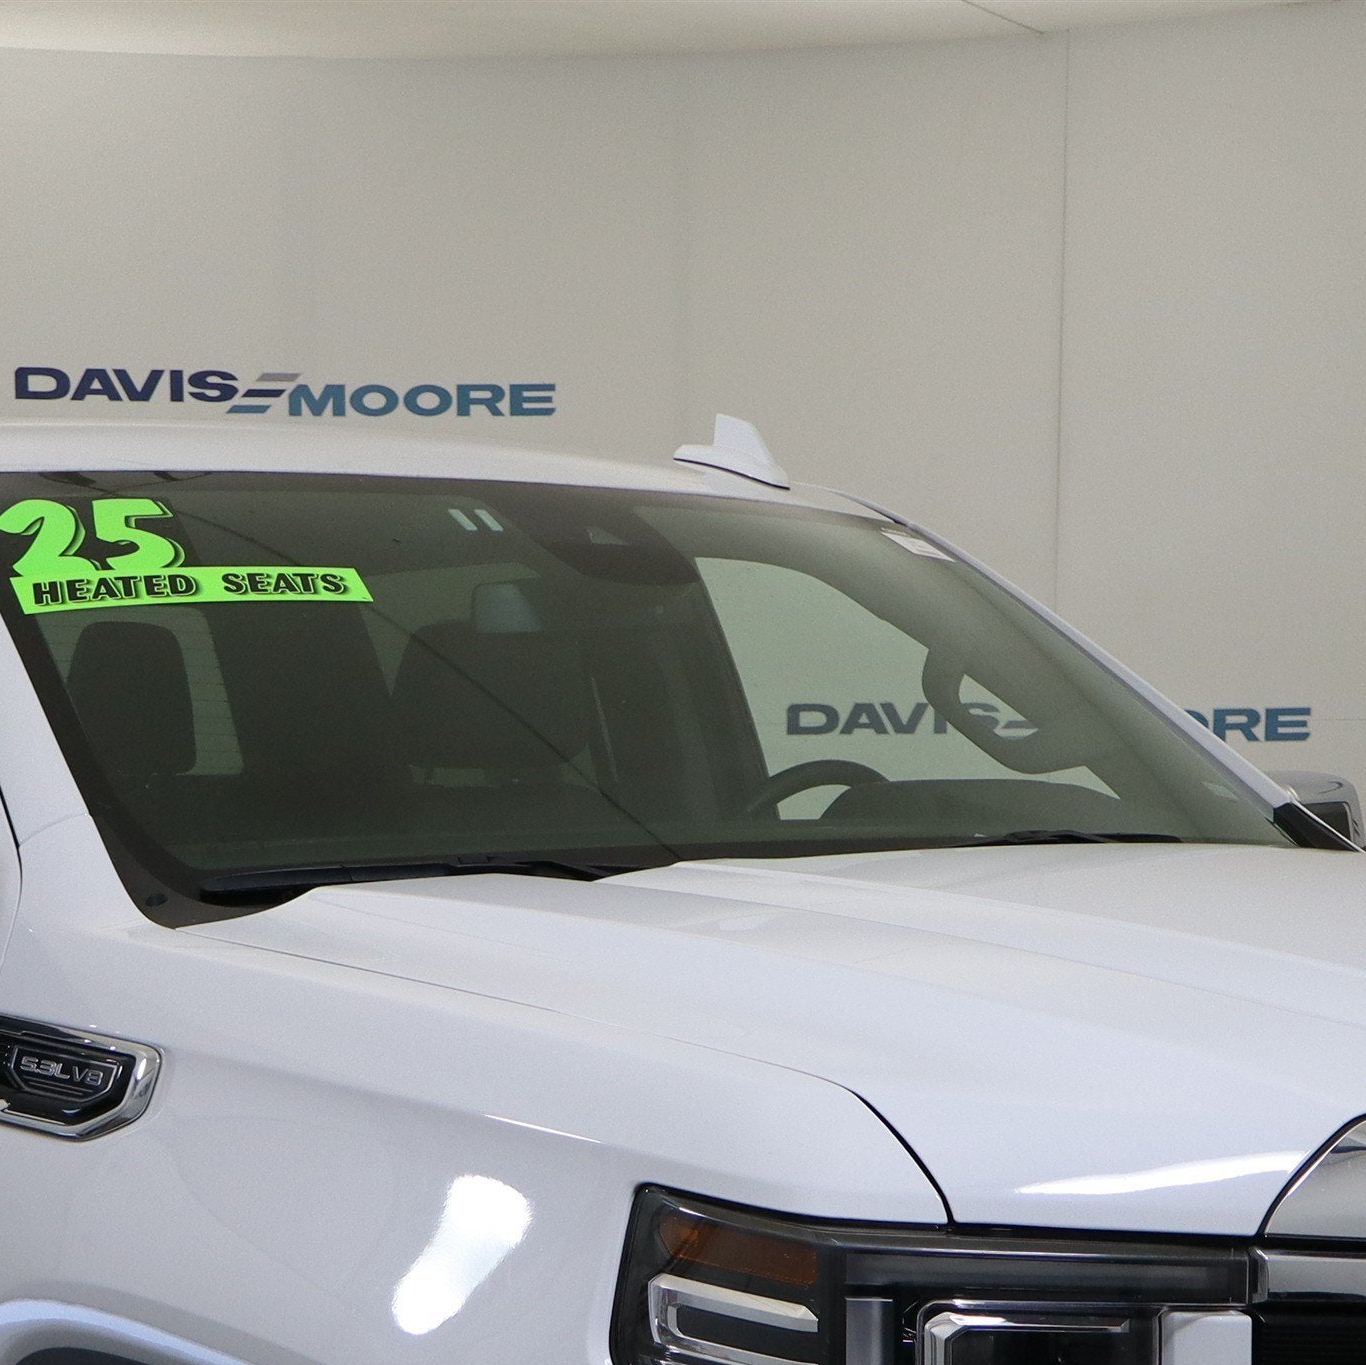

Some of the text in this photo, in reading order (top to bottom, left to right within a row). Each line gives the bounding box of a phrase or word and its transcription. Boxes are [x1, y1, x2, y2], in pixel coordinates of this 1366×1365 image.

[14, 366, 556, 417] DAVIS MOORE
[32, 571, 347, 606] HEATED SEATS
